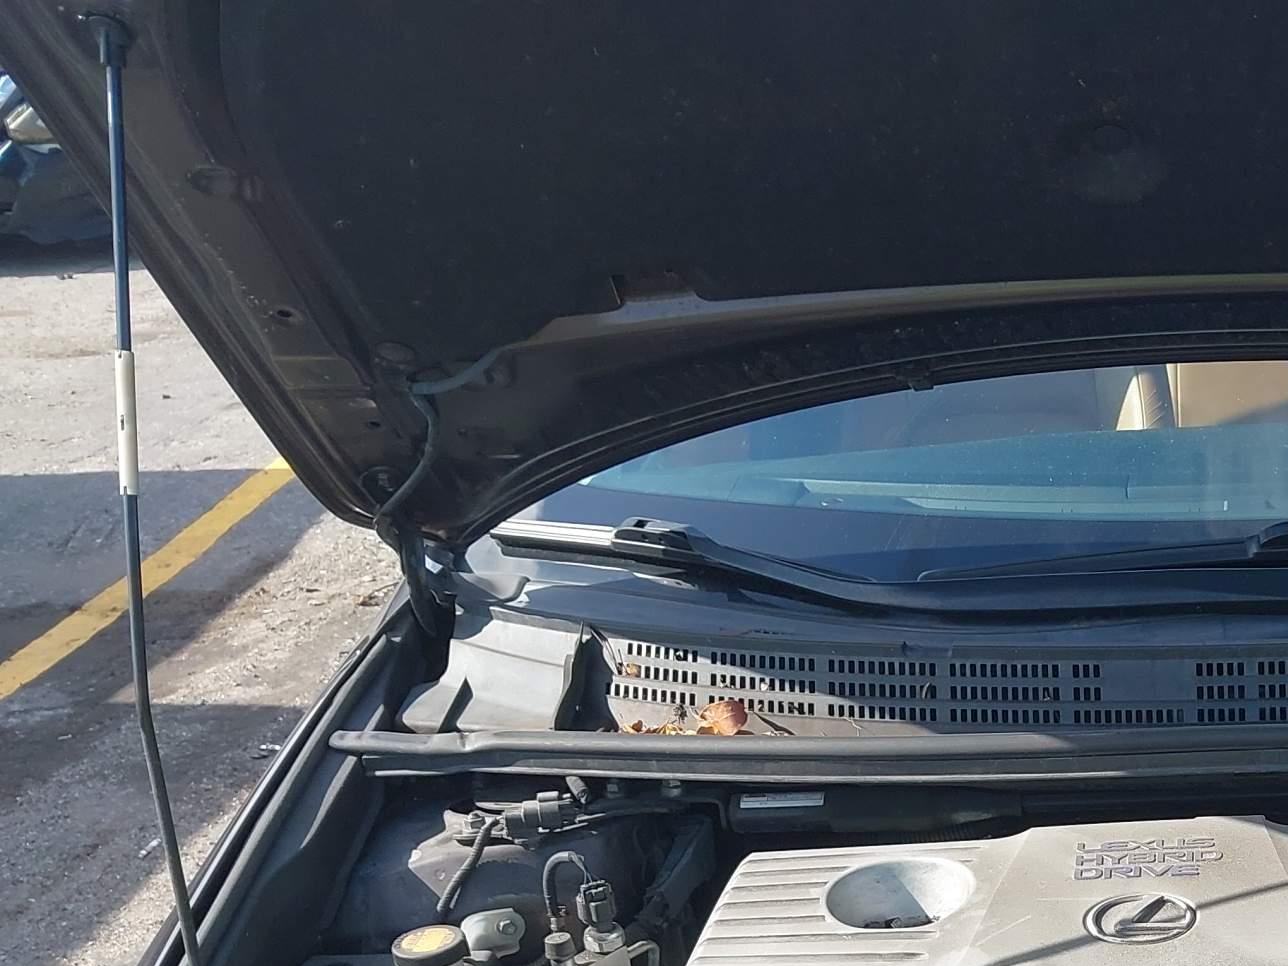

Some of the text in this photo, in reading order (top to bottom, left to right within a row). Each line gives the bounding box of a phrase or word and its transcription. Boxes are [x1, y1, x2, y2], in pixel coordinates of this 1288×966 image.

[1076, 838, 1216, 853] LEXUS
[1075, 850, 1224, 867] HYBRID
[1074, 864, 1201, 880] DRIVE
